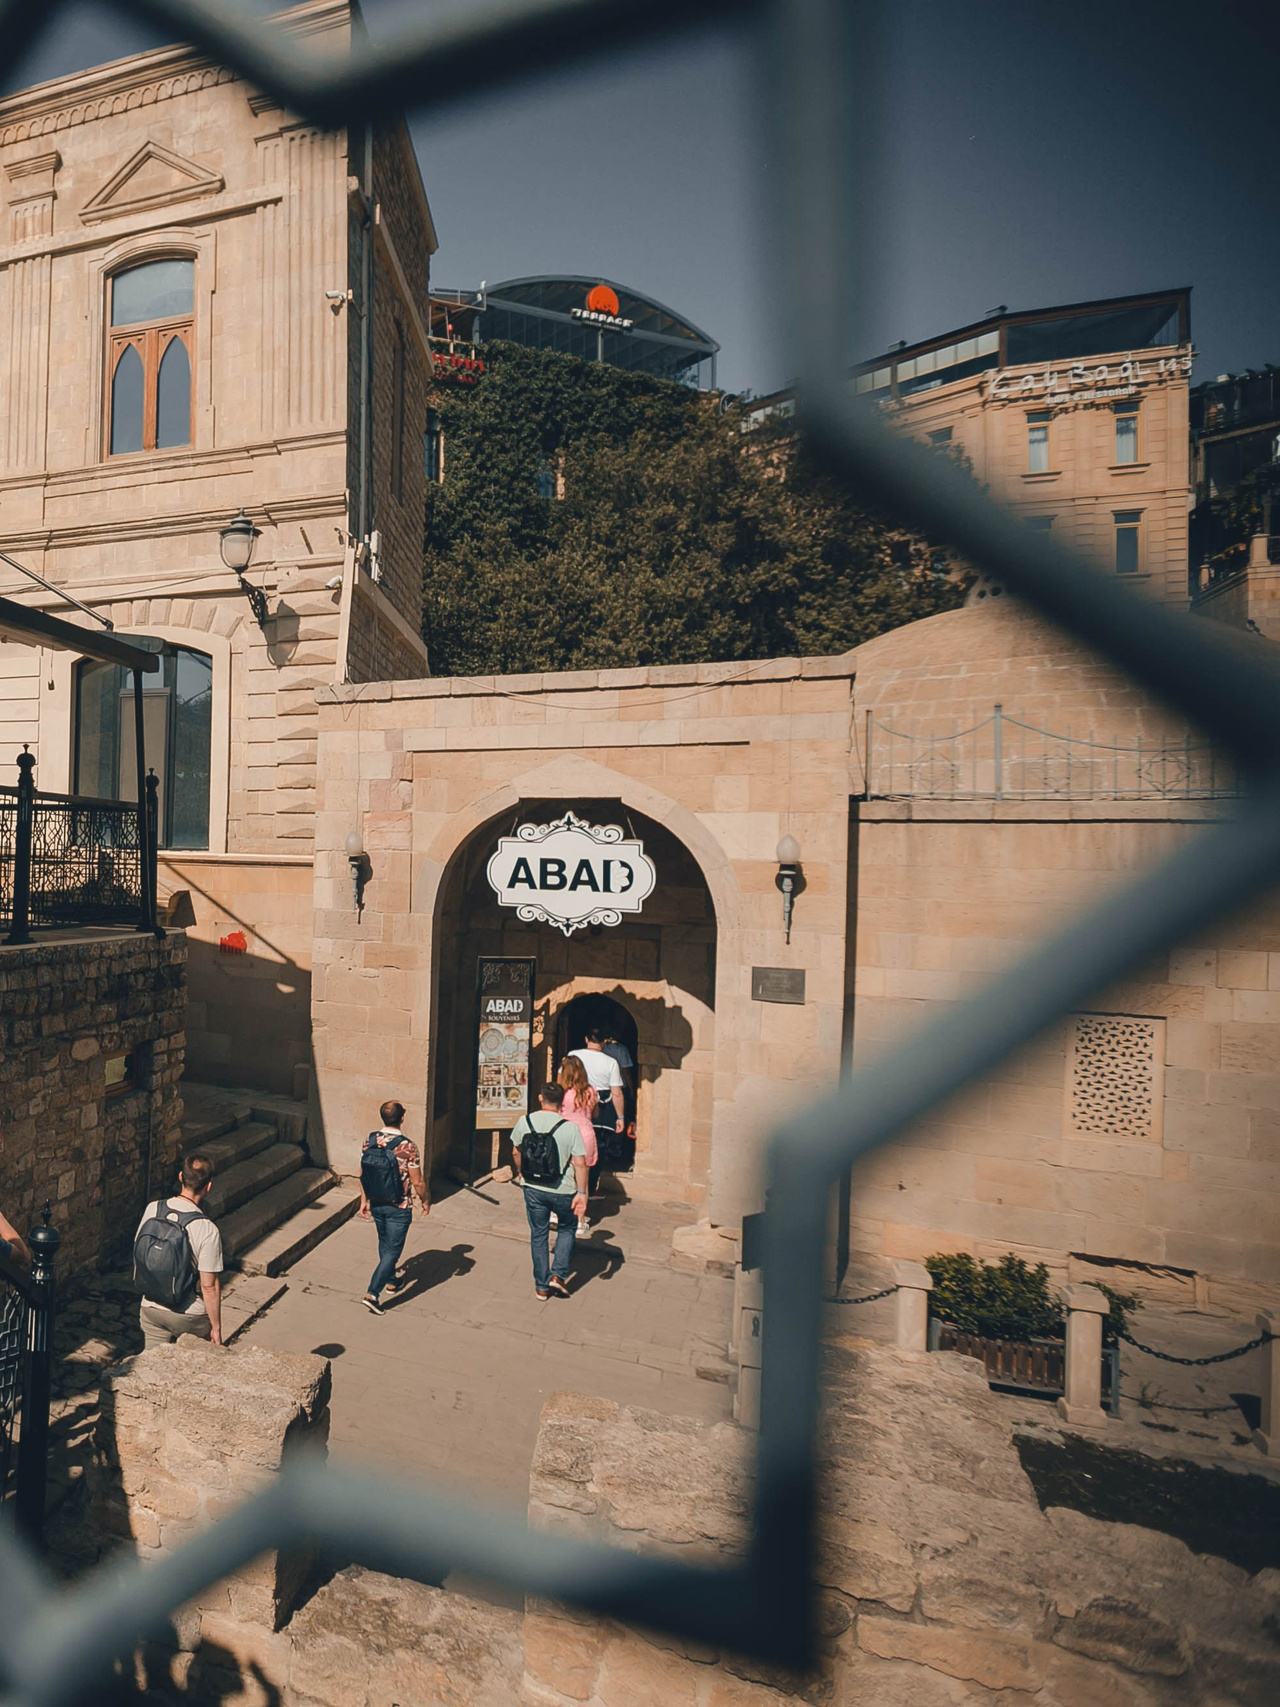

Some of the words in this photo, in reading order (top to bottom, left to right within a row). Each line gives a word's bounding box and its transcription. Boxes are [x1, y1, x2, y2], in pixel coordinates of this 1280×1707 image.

[571, 308, 633, 327] TERRACE
[1158, 357, 1193, 374] 145
[506, 857, 634, 894] ABAD
[486, 999, 524, 1013] ABAD
[488, 1014, 520, 1022] SOUVENIRS
